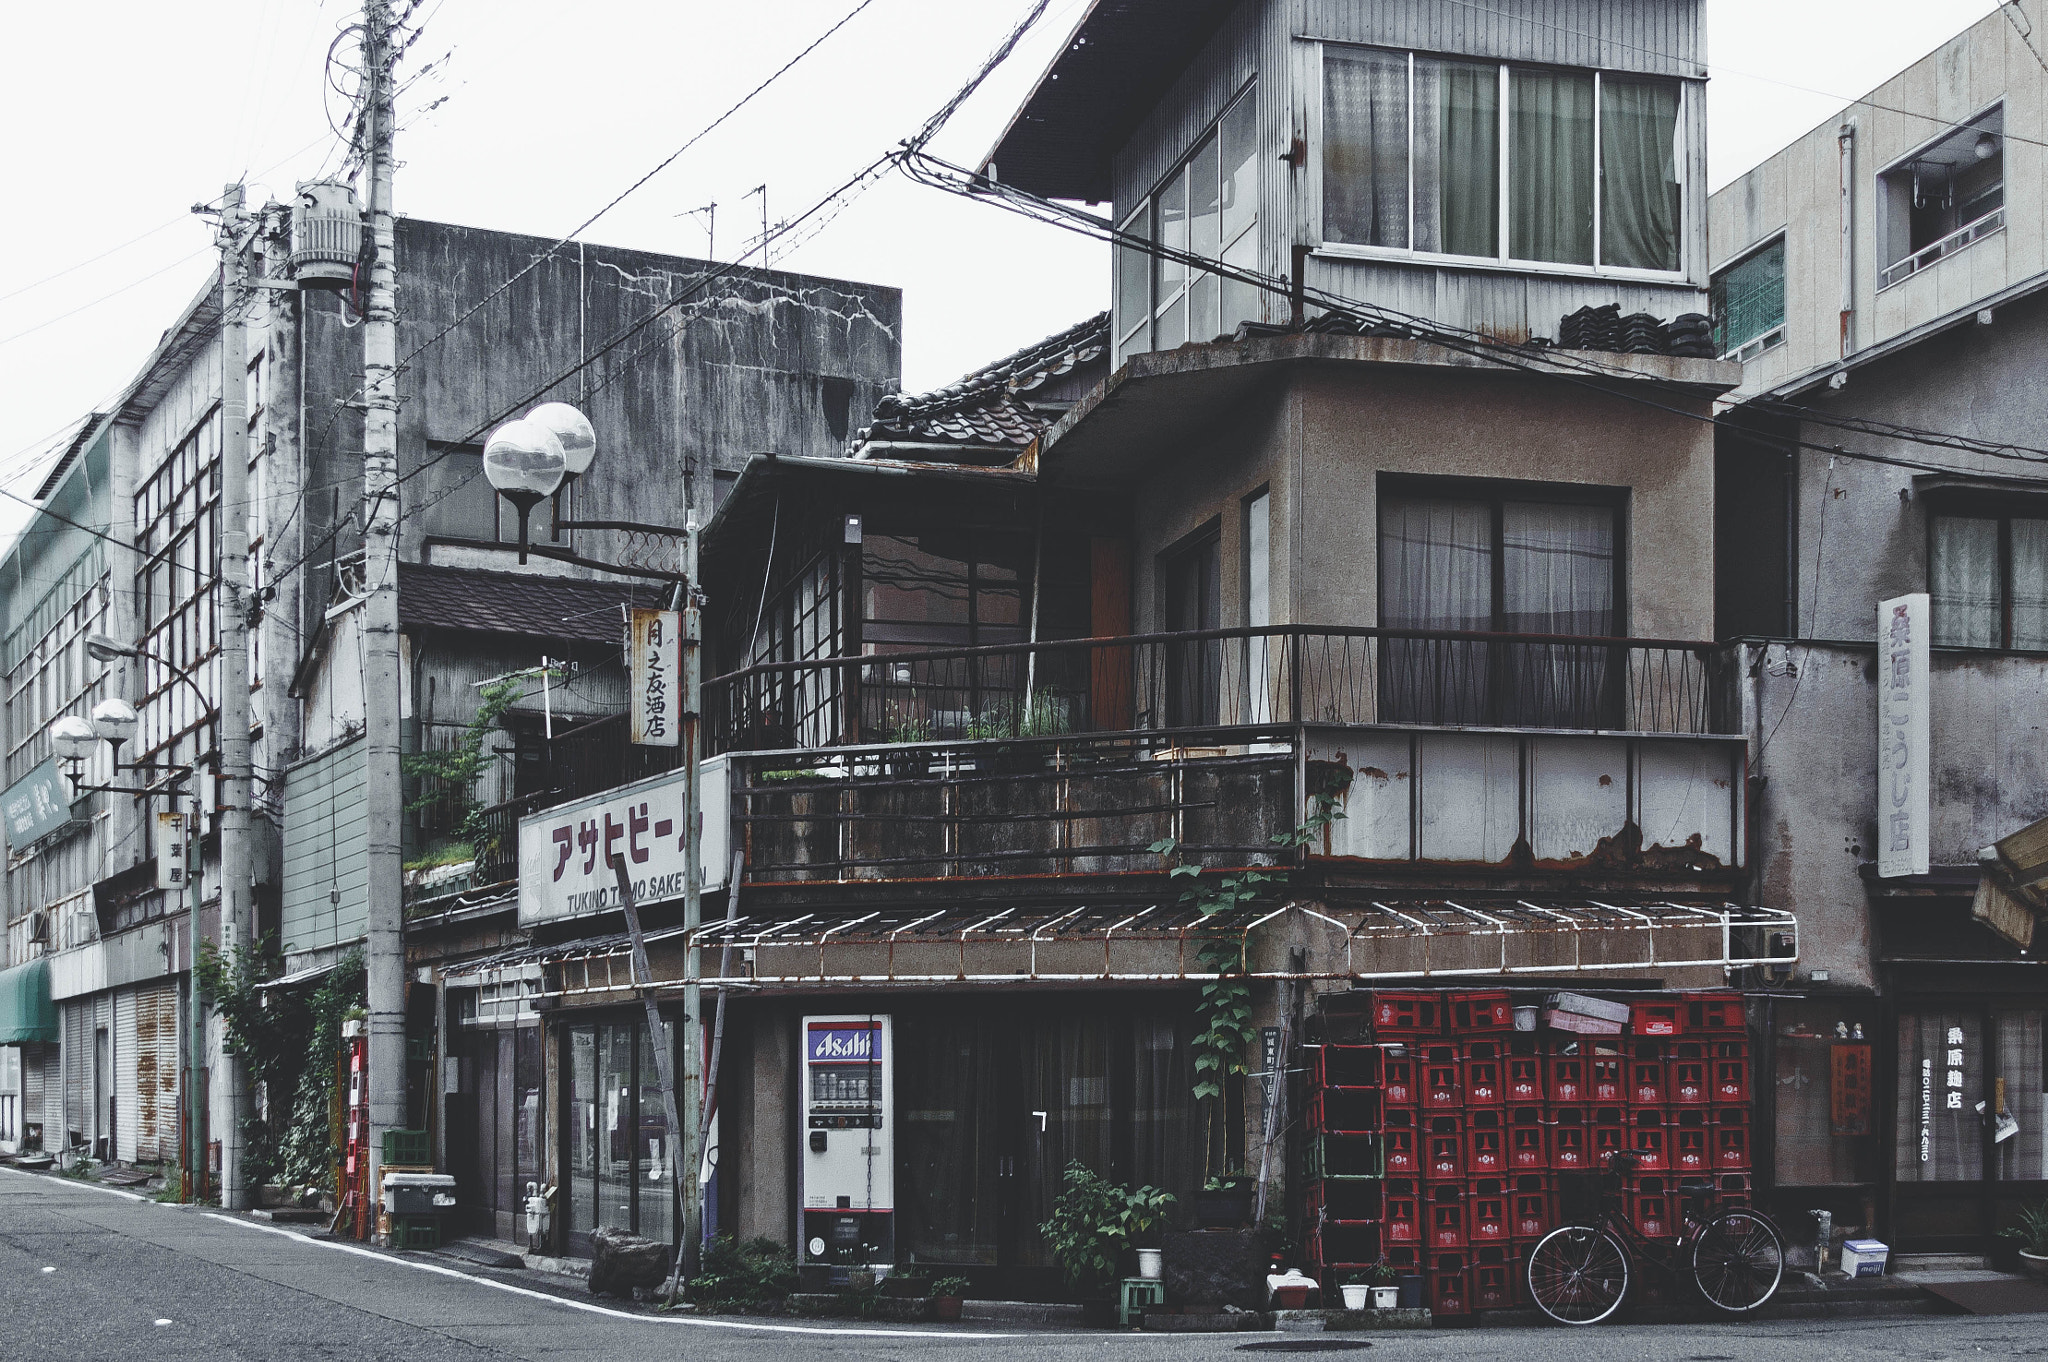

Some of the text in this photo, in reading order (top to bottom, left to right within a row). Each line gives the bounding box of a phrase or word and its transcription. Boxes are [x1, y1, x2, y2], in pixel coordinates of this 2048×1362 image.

[643, 619, 667, 738] 月之友酒店
[1889, 604, 1911, 851] 桑原こうじ店
[170, 818, 182, 883] 千葉屋
[567, 866, 707, 912] TUKINO TMO SAKEN
[815, 1031, 871, 1056] Asahi
